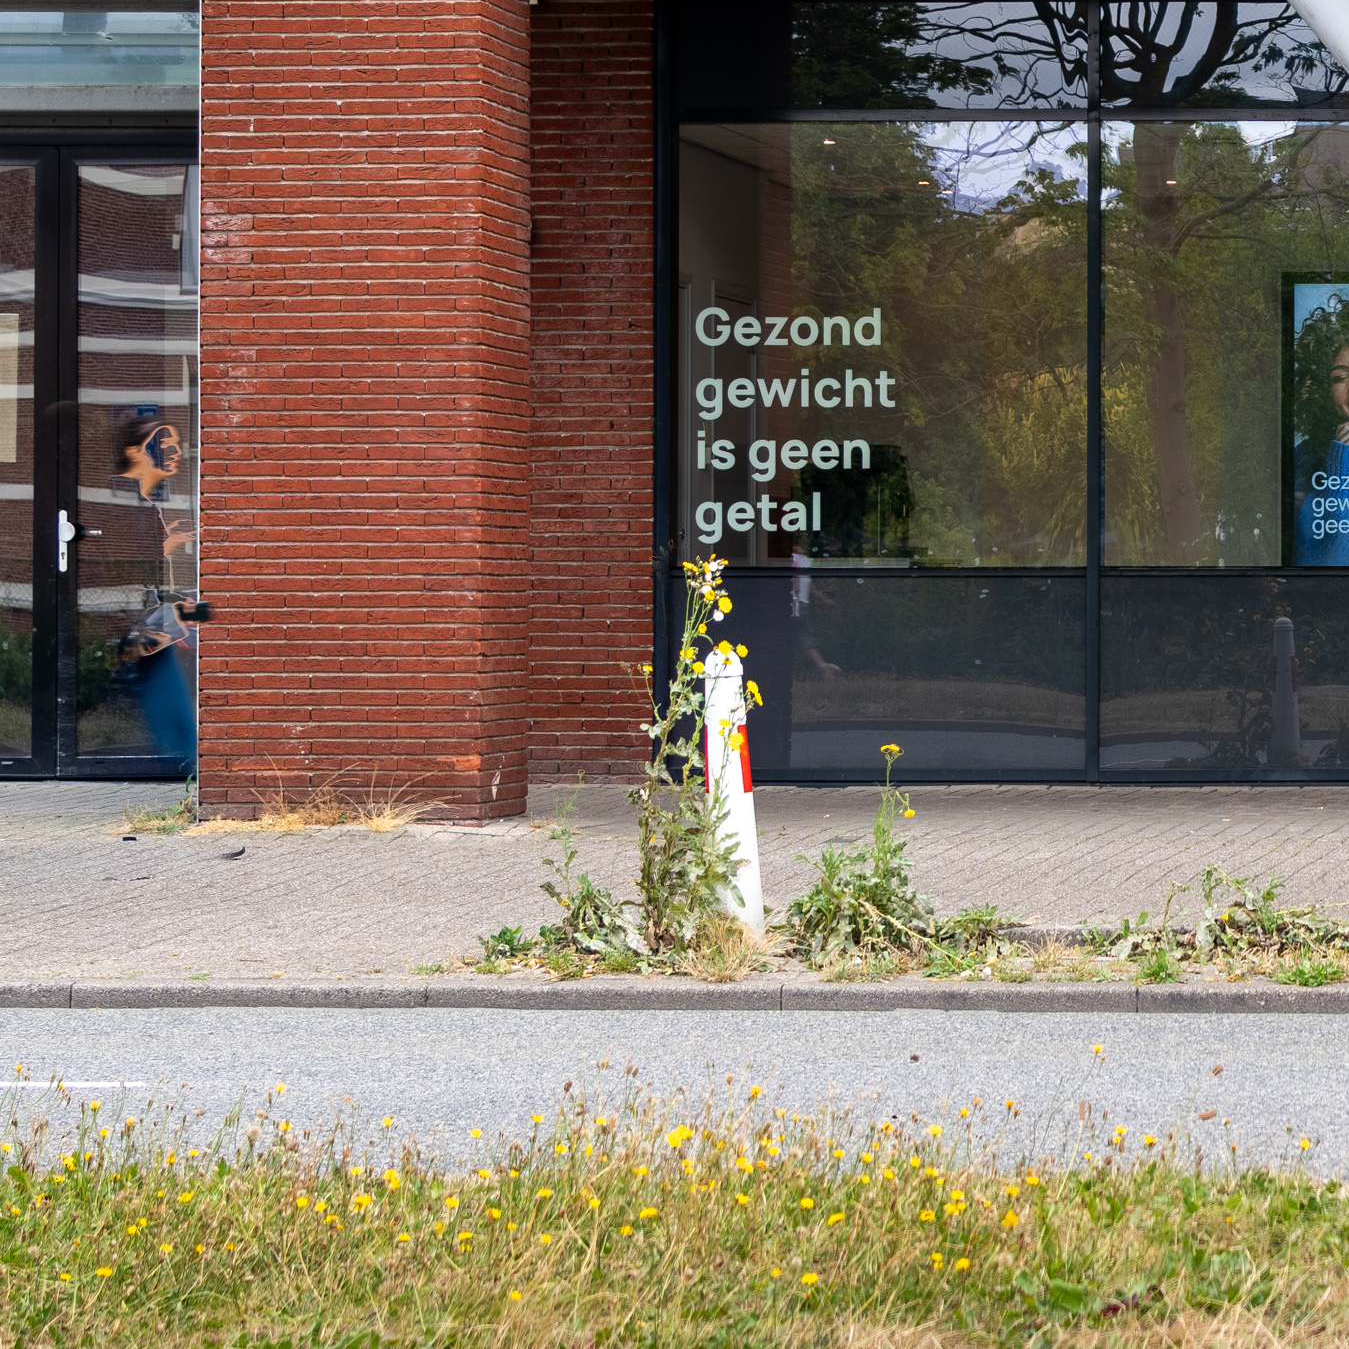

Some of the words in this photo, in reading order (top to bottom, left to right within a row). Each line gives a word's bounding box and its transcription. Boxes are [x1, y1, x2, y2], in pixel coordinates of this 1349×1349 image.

[695, 306, 882, 347] Gezond
[695, 368, 896, 420] gewicht
[697, 430, 736, 470] is
[749, 439, 871, 482] geen
[695, 491, 821, 544] getal
